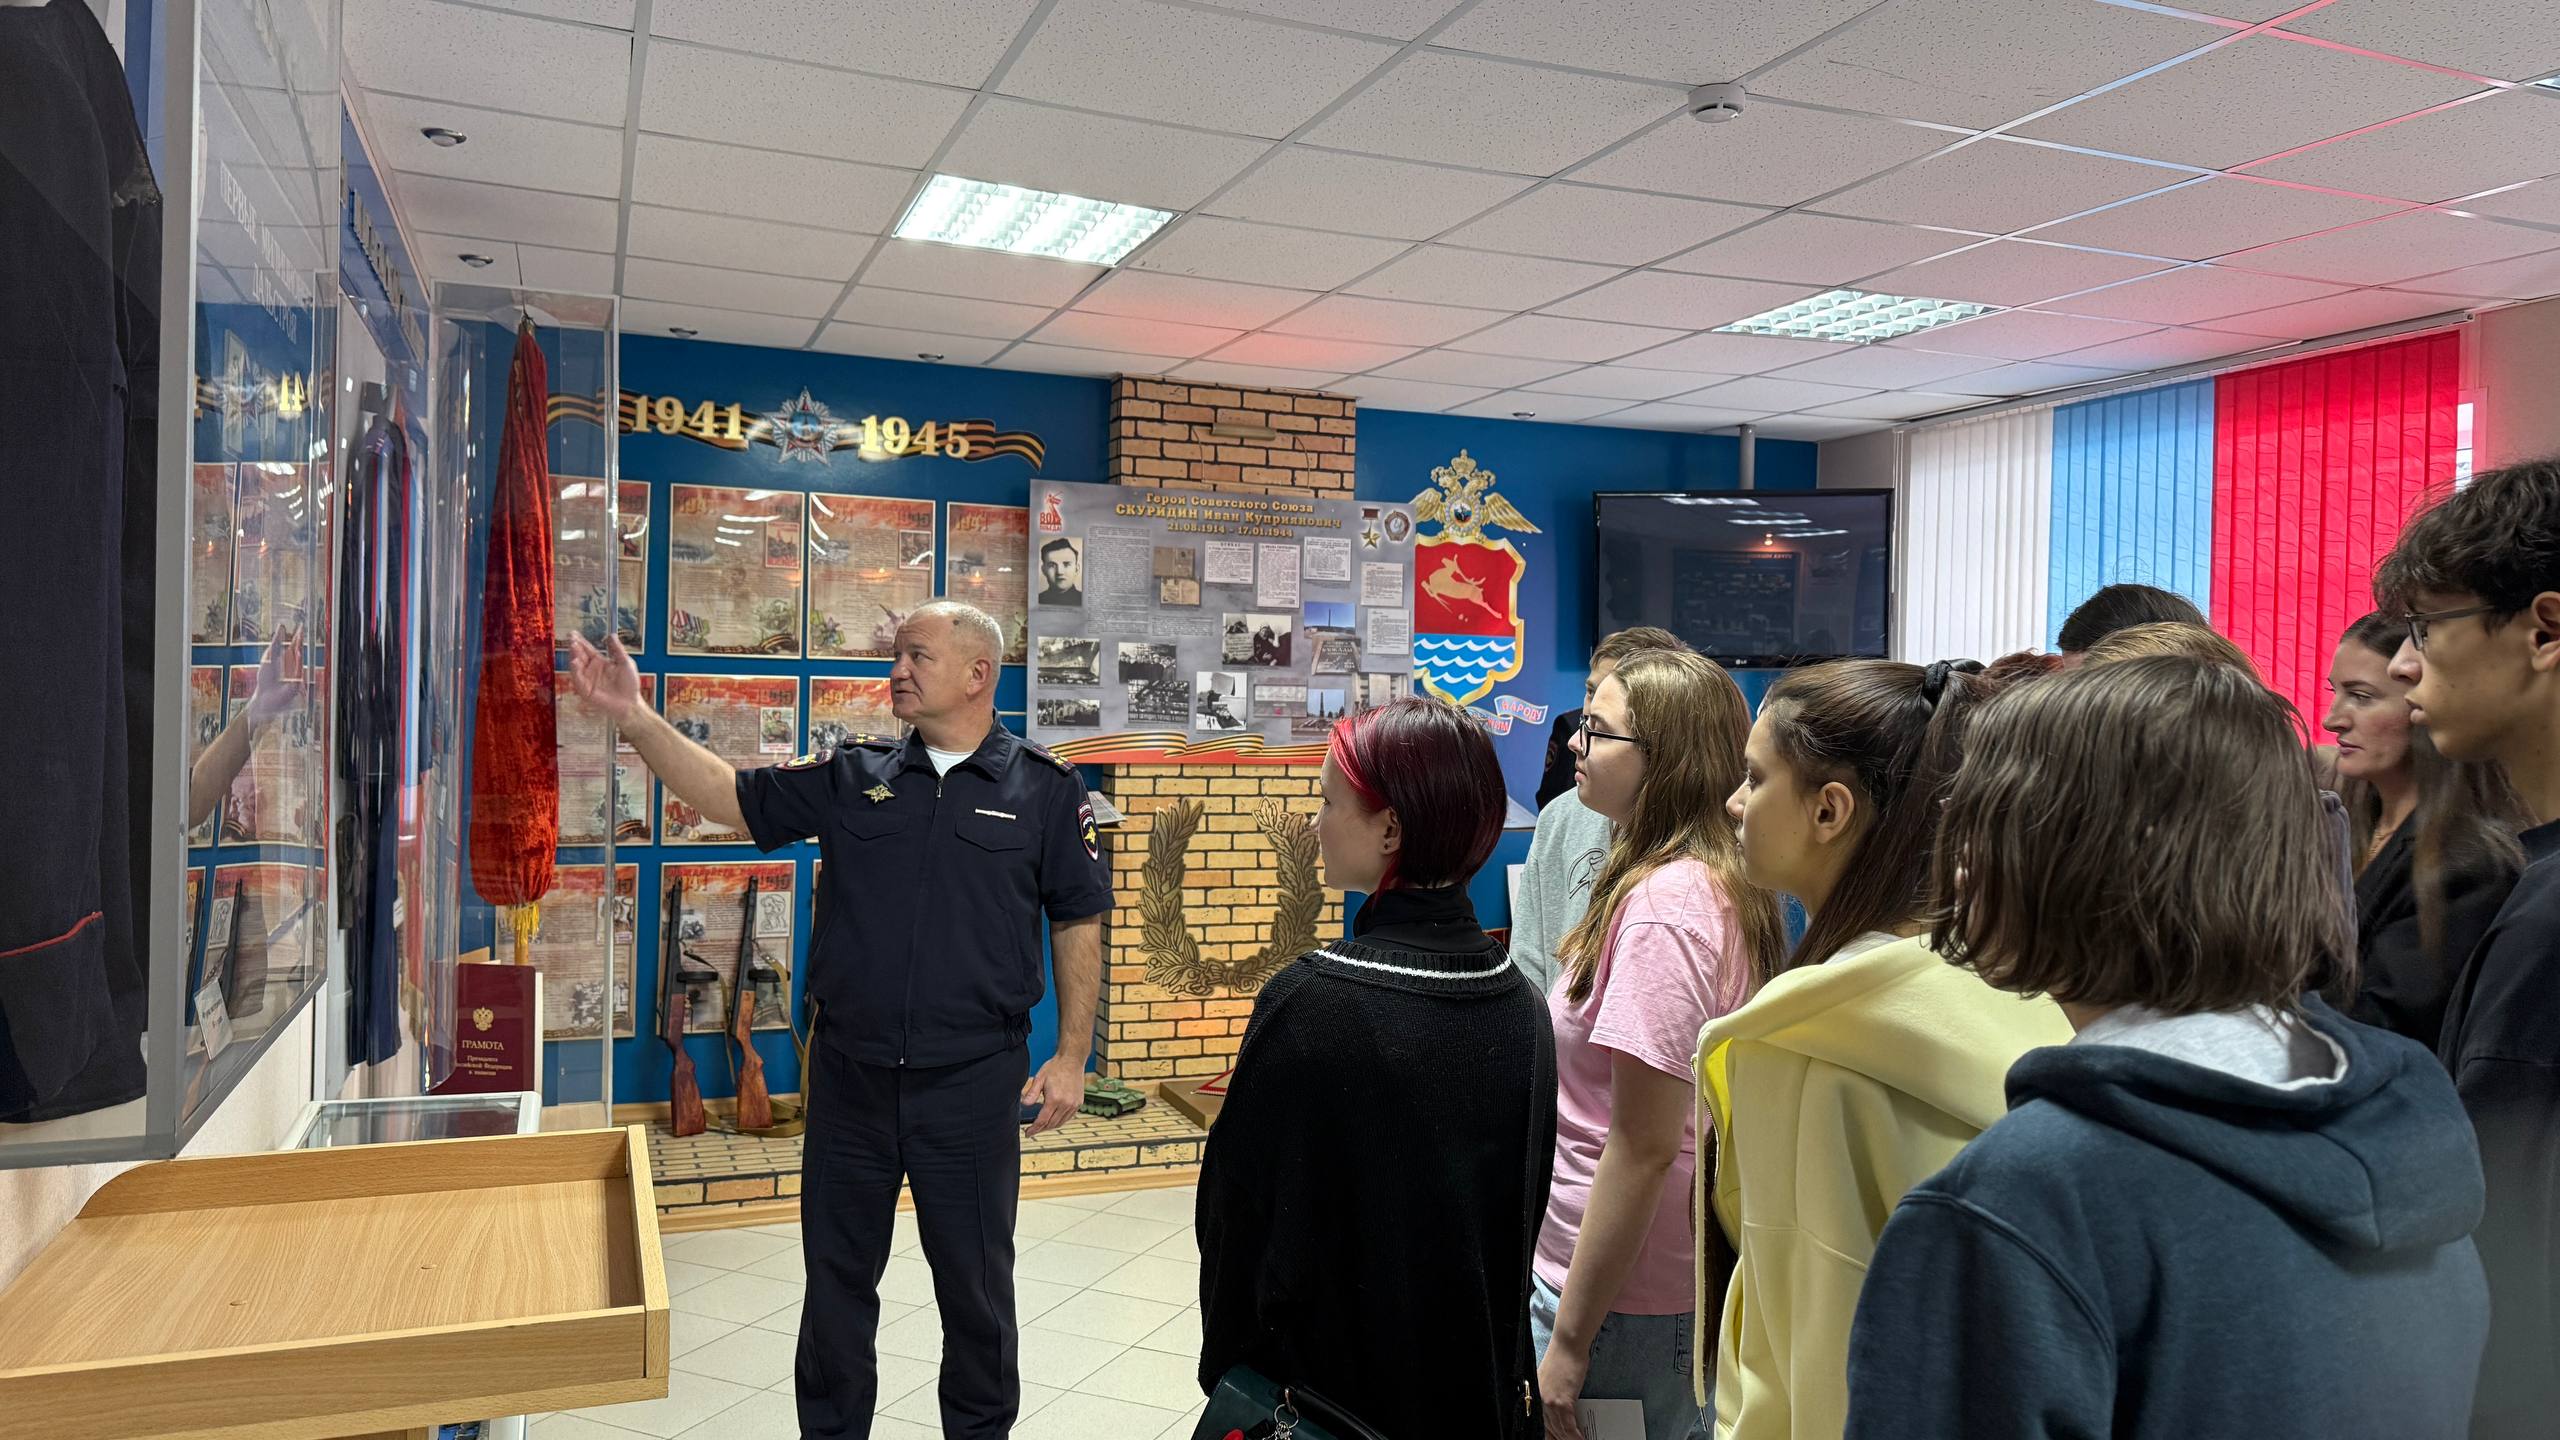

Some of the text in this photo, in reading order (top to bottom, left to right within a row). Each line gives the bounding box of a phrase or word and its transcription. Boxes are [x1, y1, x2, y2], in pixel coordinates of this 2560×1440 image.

[631, 395, 970, 459] 1941 1945
[1146, 493, 1314, 514] Герой Советского Союза
[1115, 503, 1342, 529] СКУРИДИН Иван Куприянович
[1238, 526, 1294, 538] 17.01.1944
[1502, 700, 1543, 722] НАРОДУ
[462, 1040, 504, 1050] ГРАМОТА
